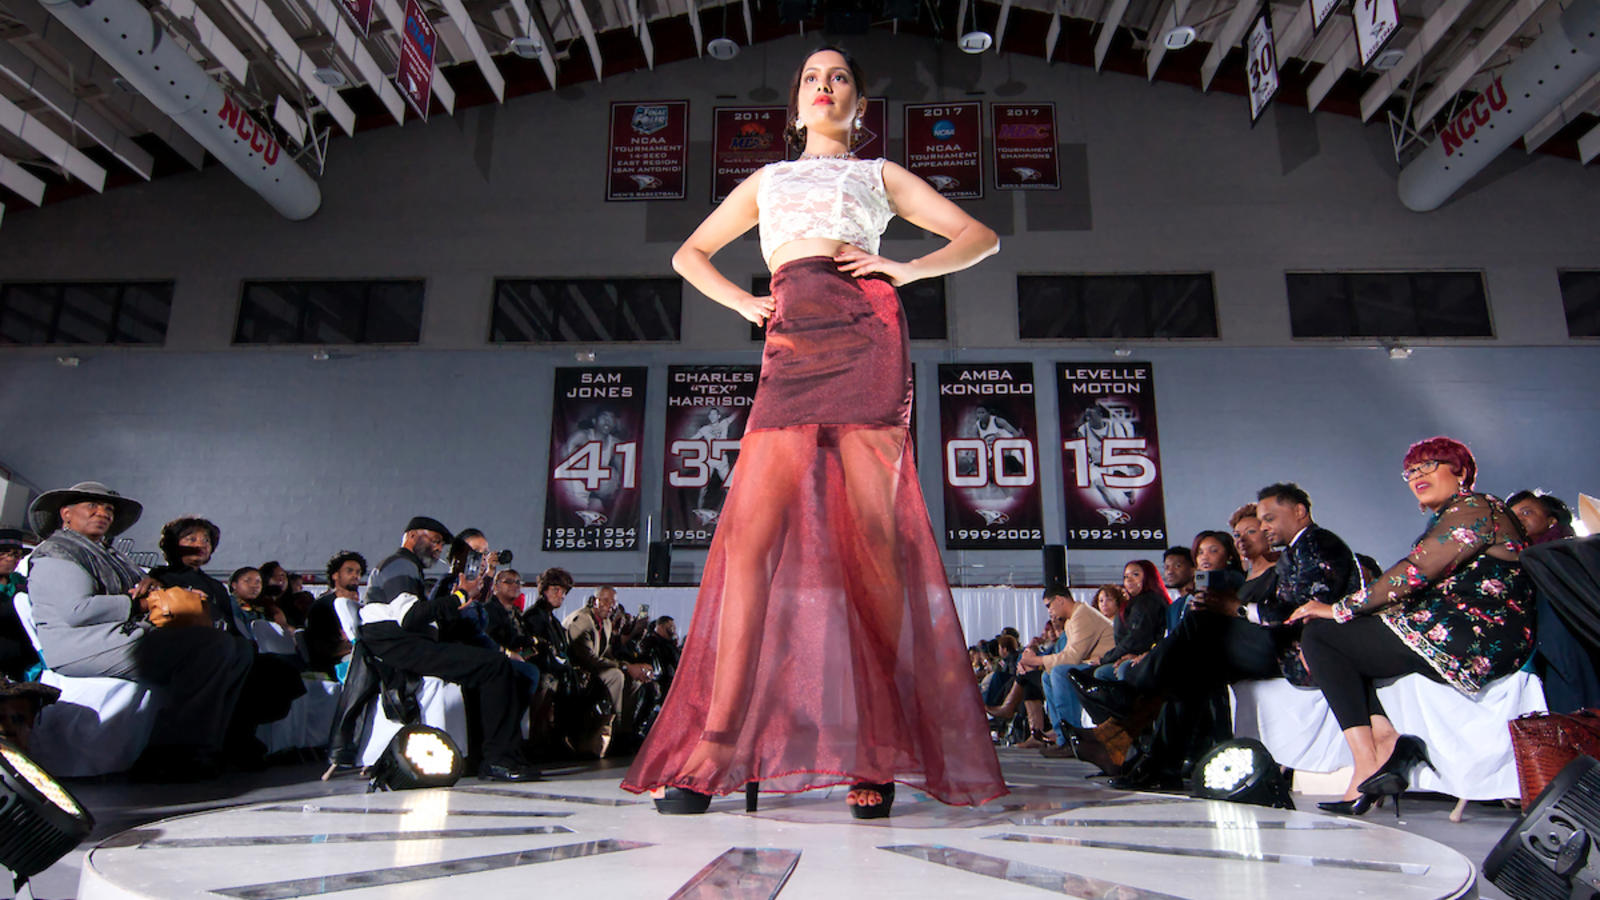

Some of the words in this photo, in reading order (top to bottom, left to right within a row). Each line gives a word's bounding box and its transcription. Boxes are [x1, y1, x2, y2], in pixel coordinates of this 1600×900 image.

[1250, 42, 1272, 93] 30
[734, 112, 770, 120] 2014
[924, 107, 963, 117] 2017
[1006, 108, 1039, 116] 2017
[1440, 75, 1508, 157] NCCU
[218, 91, 280, 166] NCCU
[630, 136, 667, 145] NCAA
[926, 144, 961, 152] NCAA
[910, 152, 978, 160] TOURNAMENT
[911, 159, 977, 168] APPEARANCE
[581, 372, 622, 384] SAM
[674, 372, 754, 383] CHARLES
[959, 369, 1013, 381] AMBA
[1065, 369, 1147, 380] LEVELLE
[567, 387, 633, 398] JONES
[940, 383, 1033, 395] KONGOLO
[1072, 382, 1141, 393] MOTON
[553, 440, 638, 491] 41
[669, 438, 741, 489] 37
[946, 438, 1035, 488] 00
[1064, 437, 1158, 489] 15
[546, 527, 636, 538] 1951-1954
[665, 530, 711, 540] 1950-
[949, 529, 1042, 540] 1999-2002
[1070, 529, 1164, 540] 1992-1996
[545, 538, 636, 548] 1956-1957
